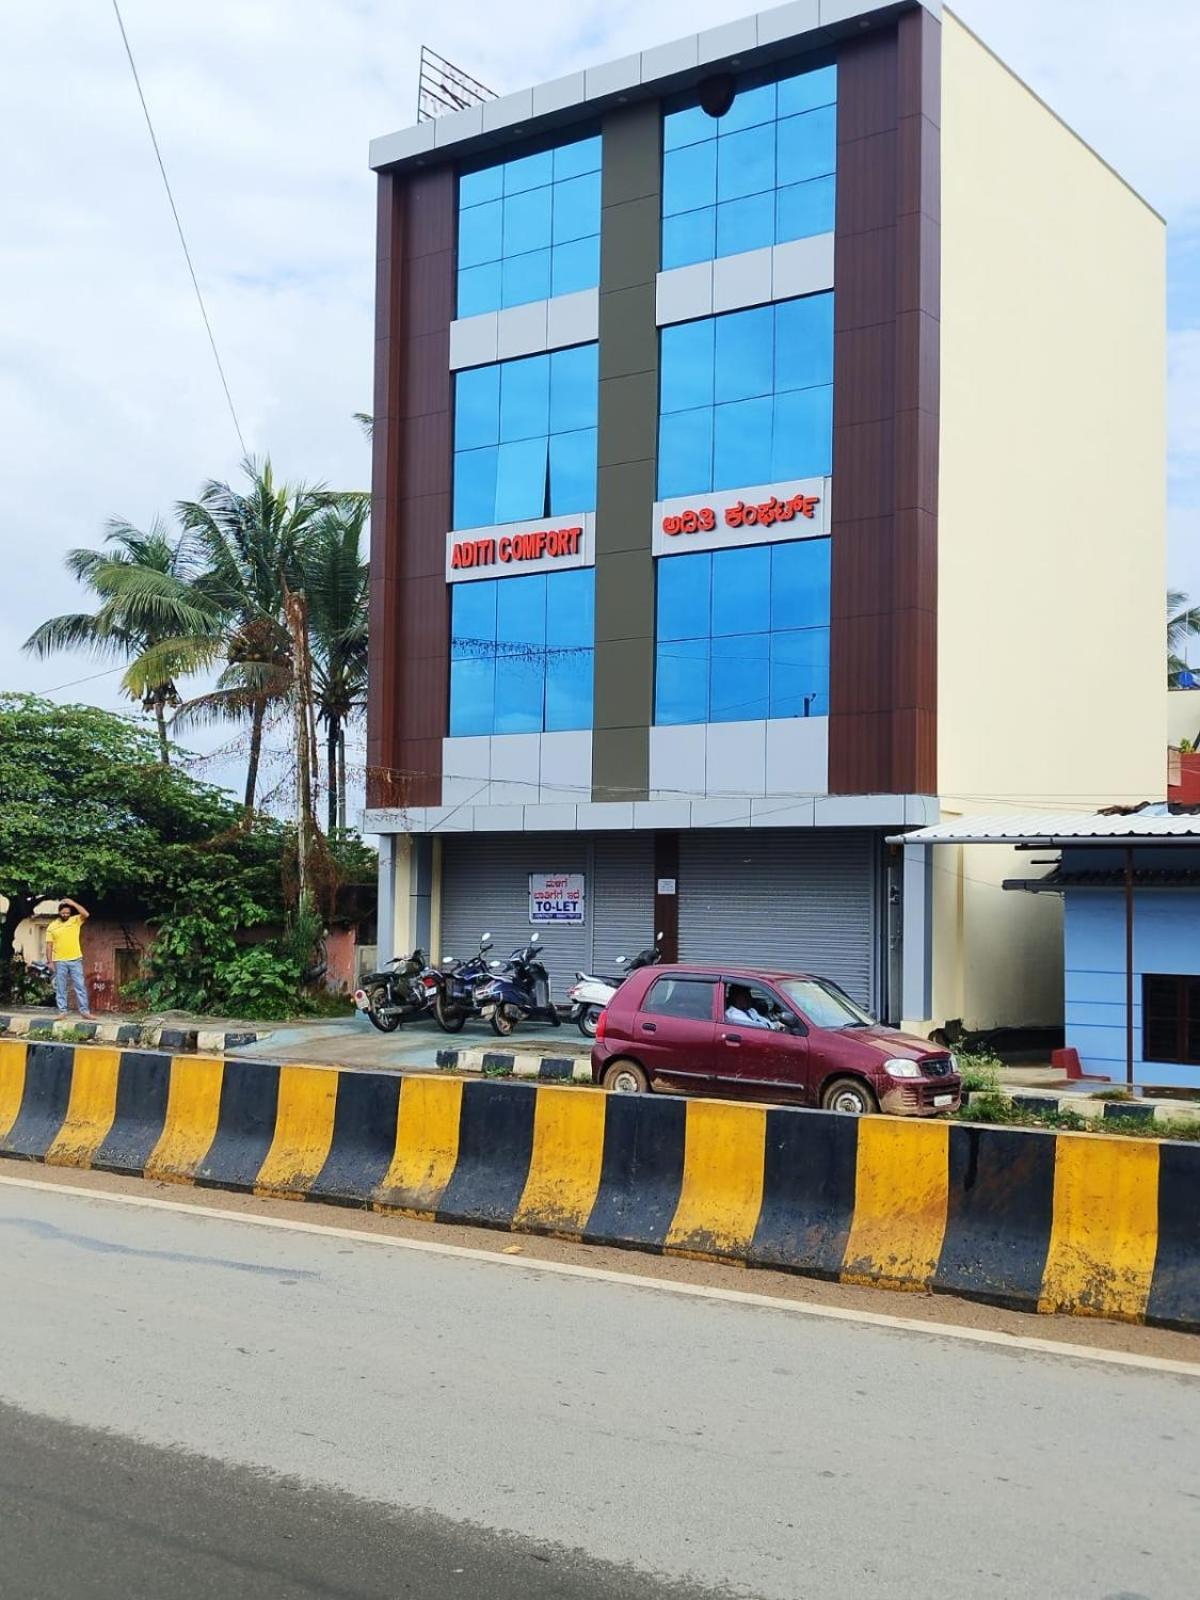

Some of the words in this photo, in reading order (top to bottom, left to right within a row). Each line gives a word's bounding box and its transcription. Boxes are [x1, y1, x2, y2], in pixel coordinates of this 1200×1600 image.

[662, 507, 717, 536] ಅದಿತಿ
[451, 539, 495, 569] ADITI
[498, 527, 583, 563] COMFORT
[535, 900, 579, 912] TO-LET
